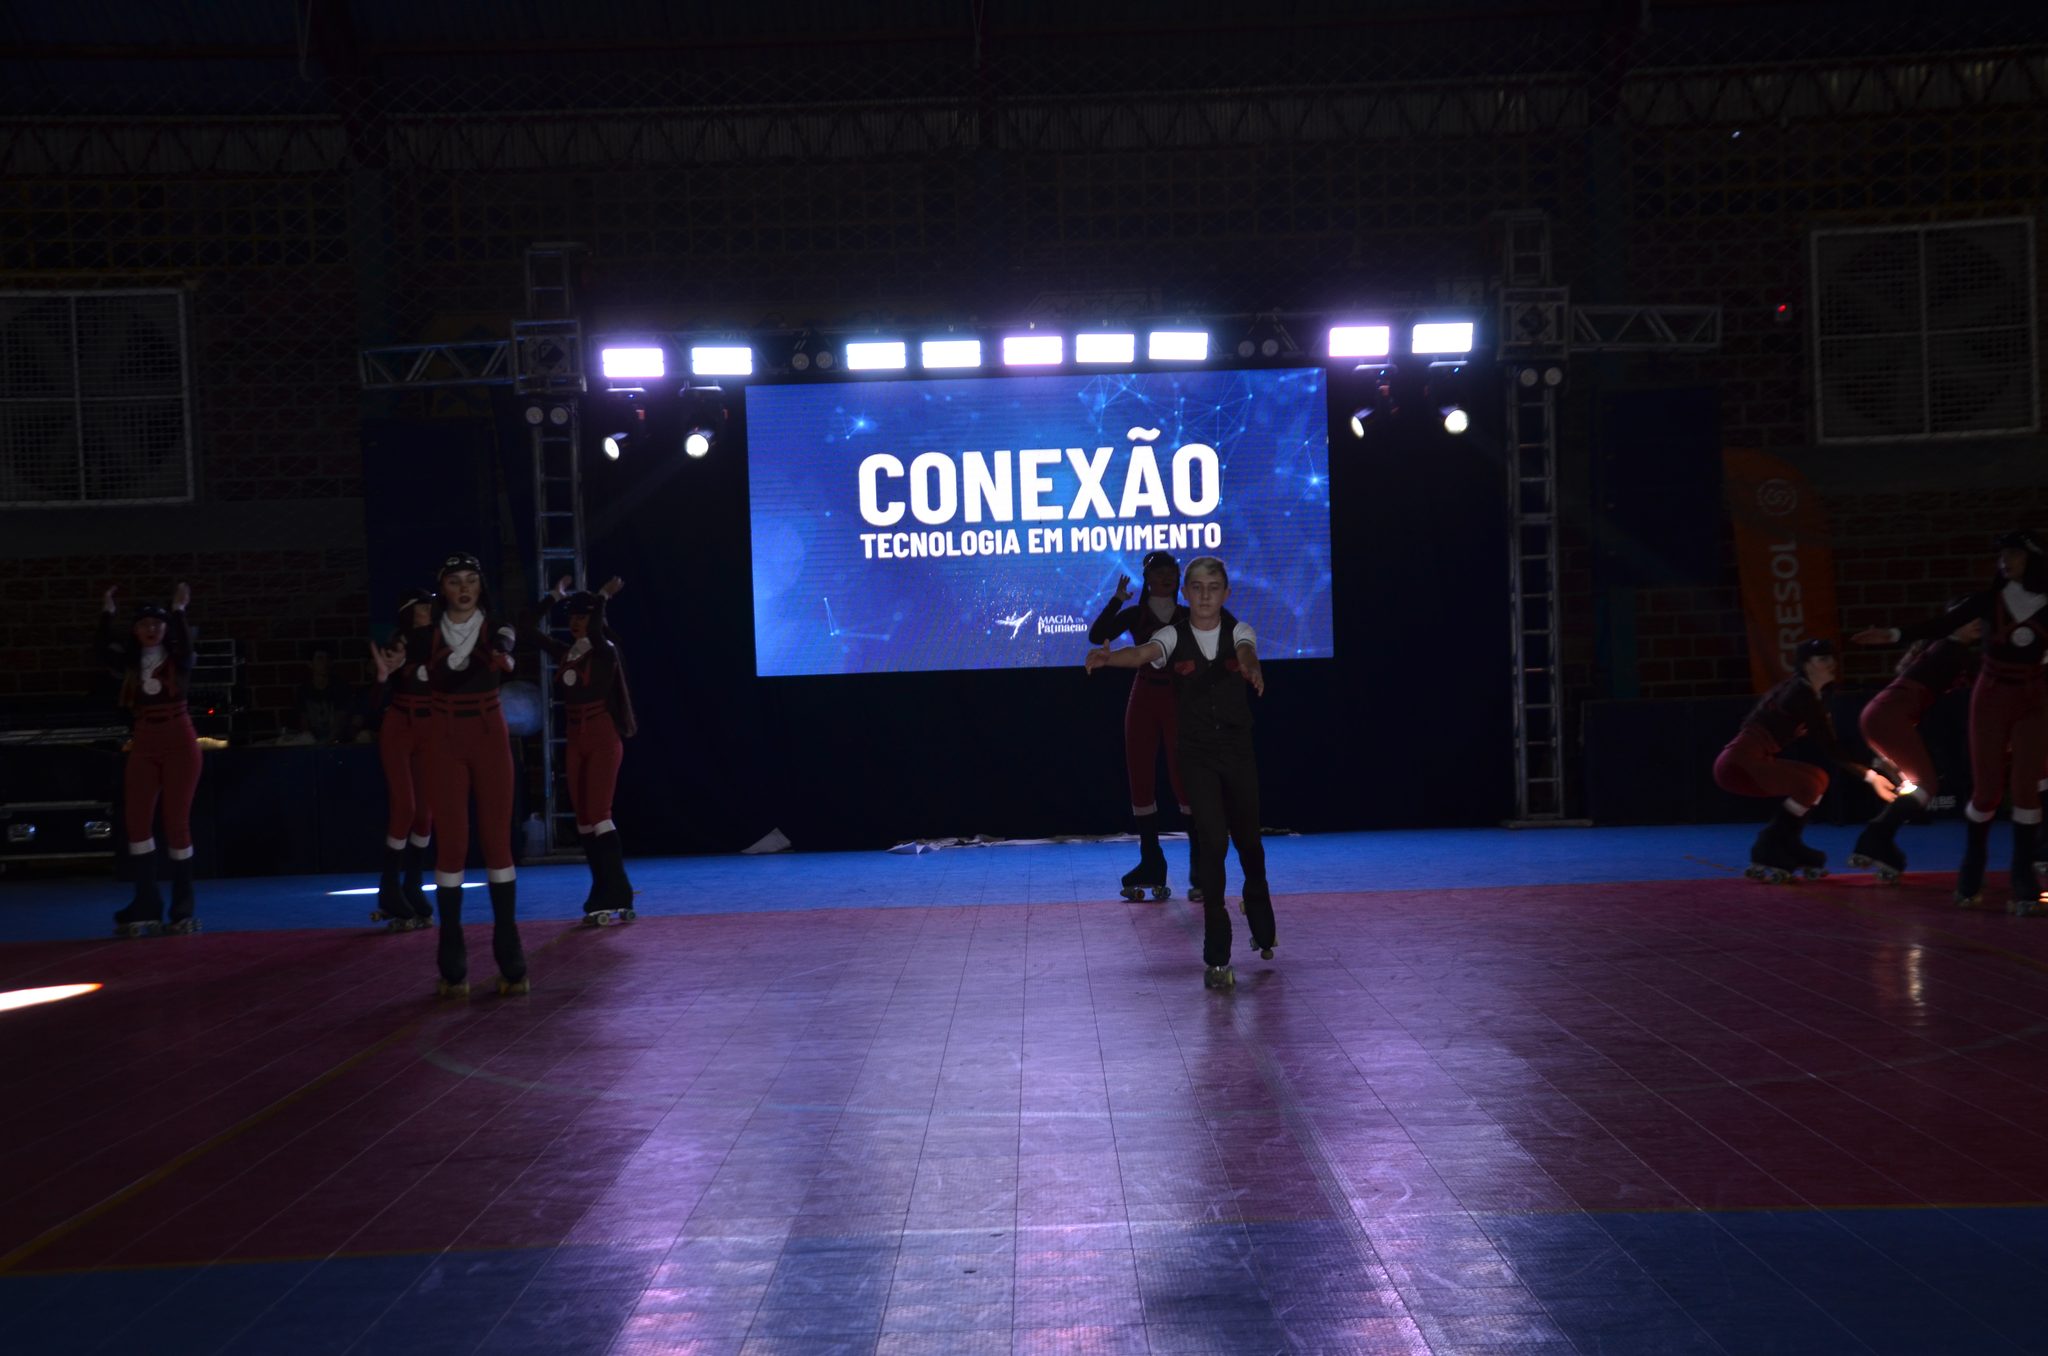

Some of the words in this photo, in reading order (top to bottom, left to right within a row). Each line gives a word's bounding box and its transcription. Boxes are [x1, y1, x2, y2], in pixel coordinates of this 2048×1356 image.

[858, 426, 1220, 526] CONEXÃO
[859, 529, 1021, 559] TECNOLOGIA
[1028, 527, 1063, 554] EM
[1070, 522, 1222, 552] MOVIMENTO
[1038, 614, 1074, 624] MAGIA
[1768, 531, 1804, 674] CRESOL
